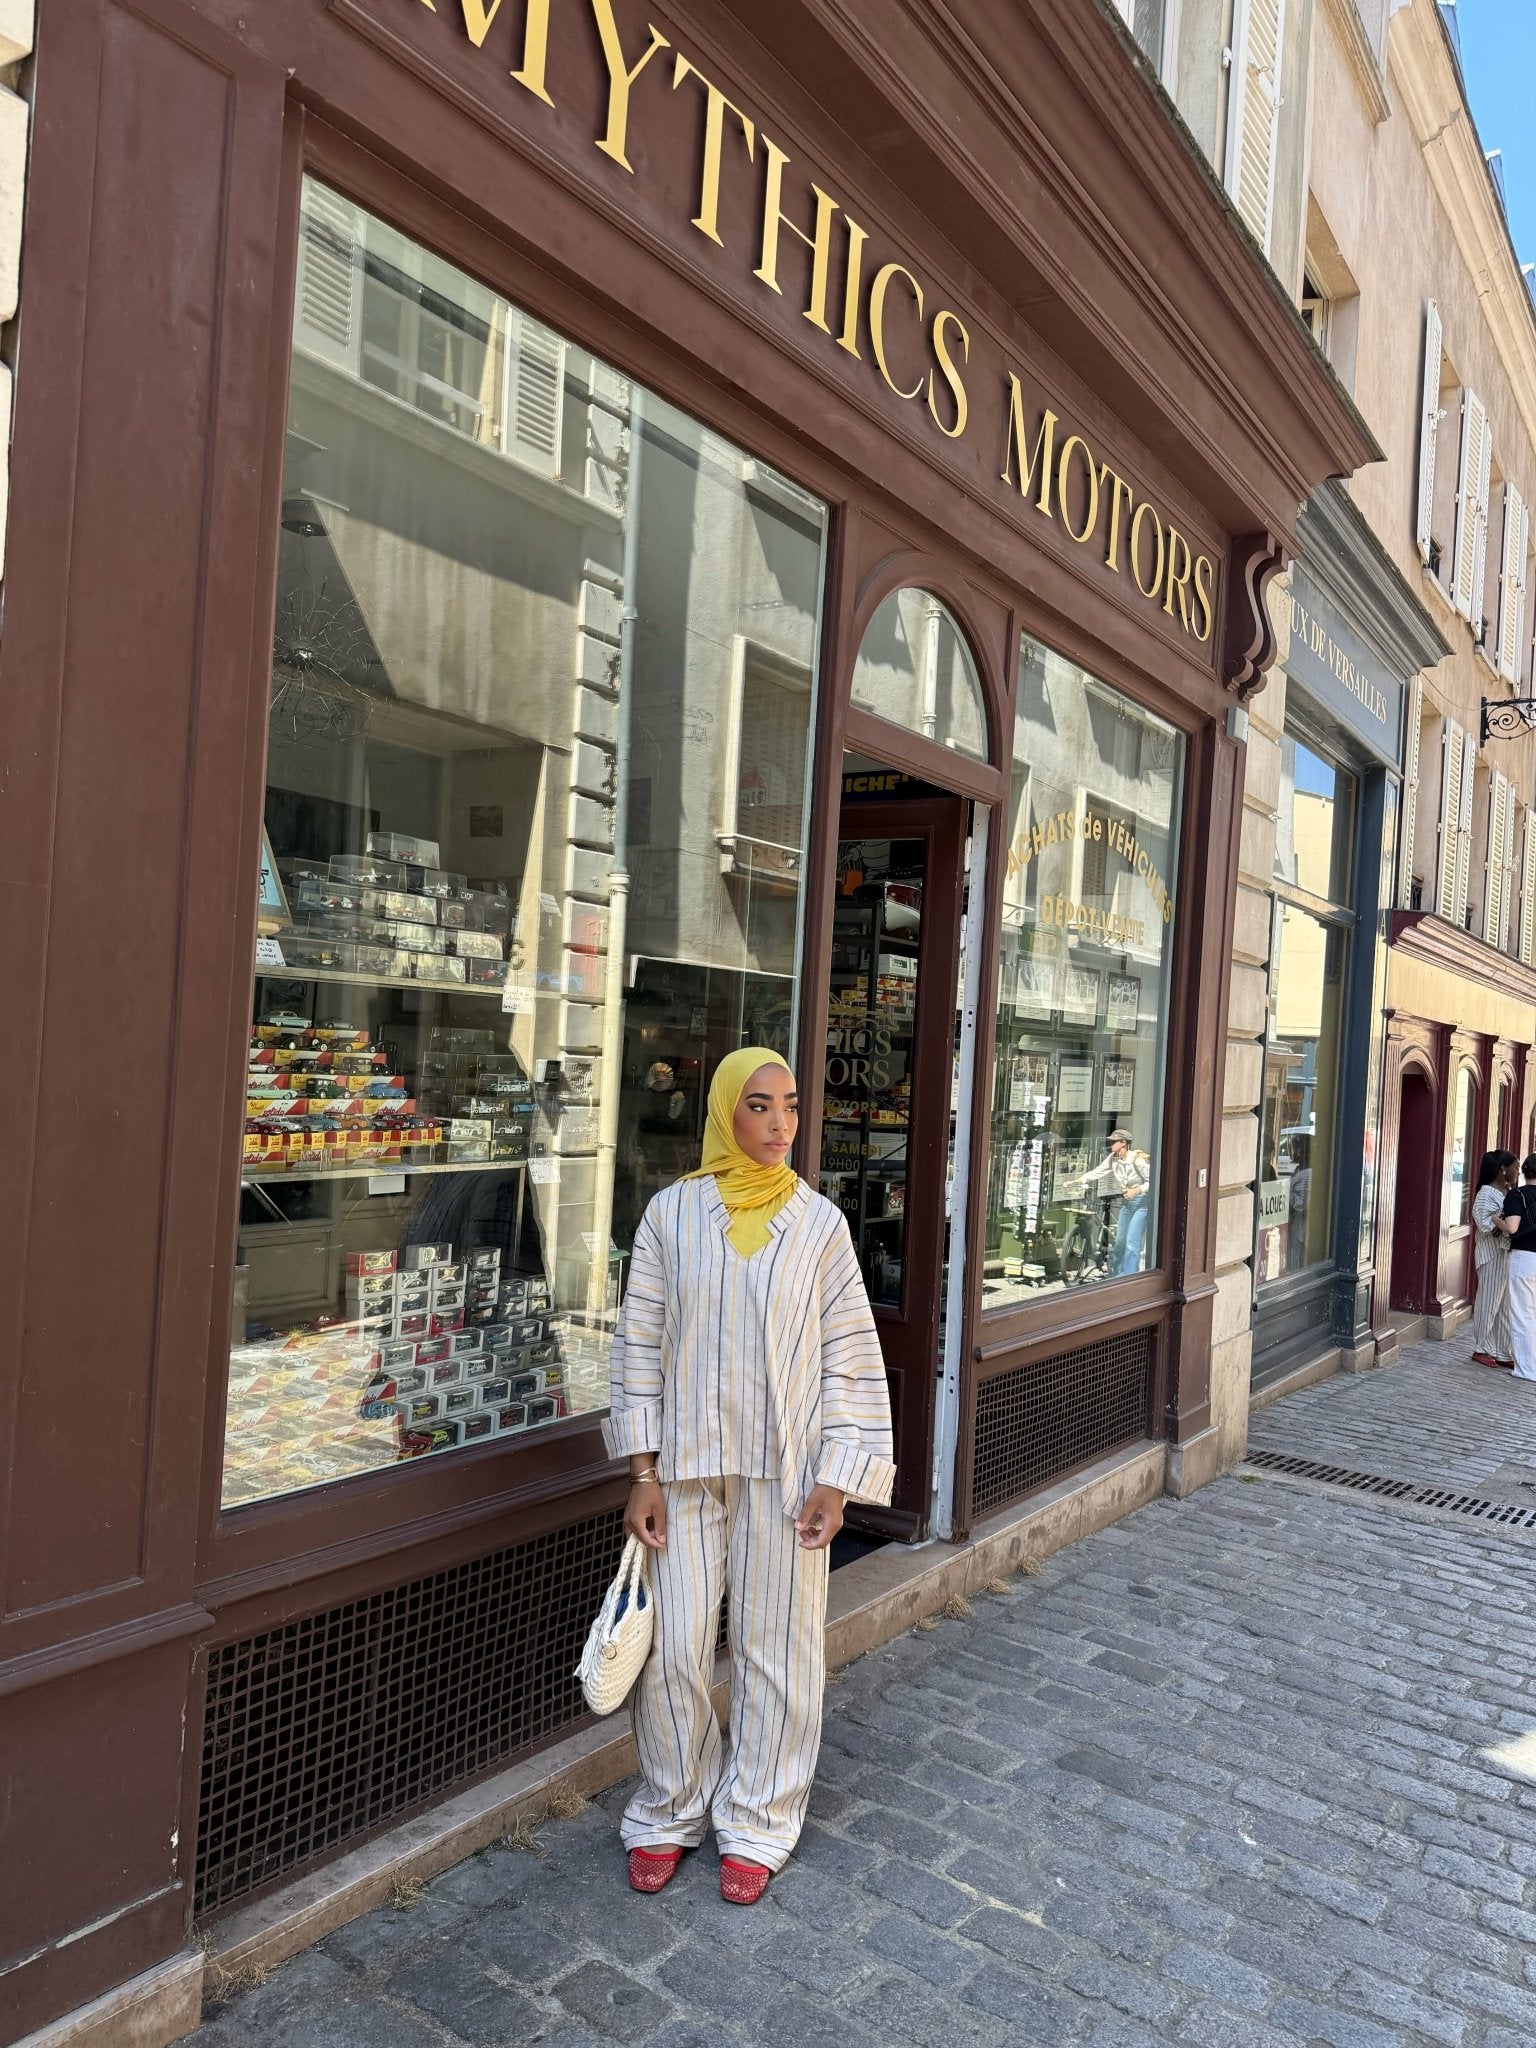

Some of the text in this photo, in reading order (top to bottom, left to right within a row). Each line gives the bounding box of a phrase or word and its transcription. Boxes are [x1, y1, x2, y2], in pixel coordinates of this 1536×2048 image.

[1000, 371, 1213, 643] MOTORS
[1310, 618, 1326, 662] DE
[1328, 638, 1387, 725] VERSAILLES
[841, 774, 908, 793] ICHE
[1006, 812, 1173, 924] ACHATS de VÉHICULES
[831, 1141, 882, 1156] SAMEDI
[1265, 1193, 1286, 1216] LOUER
